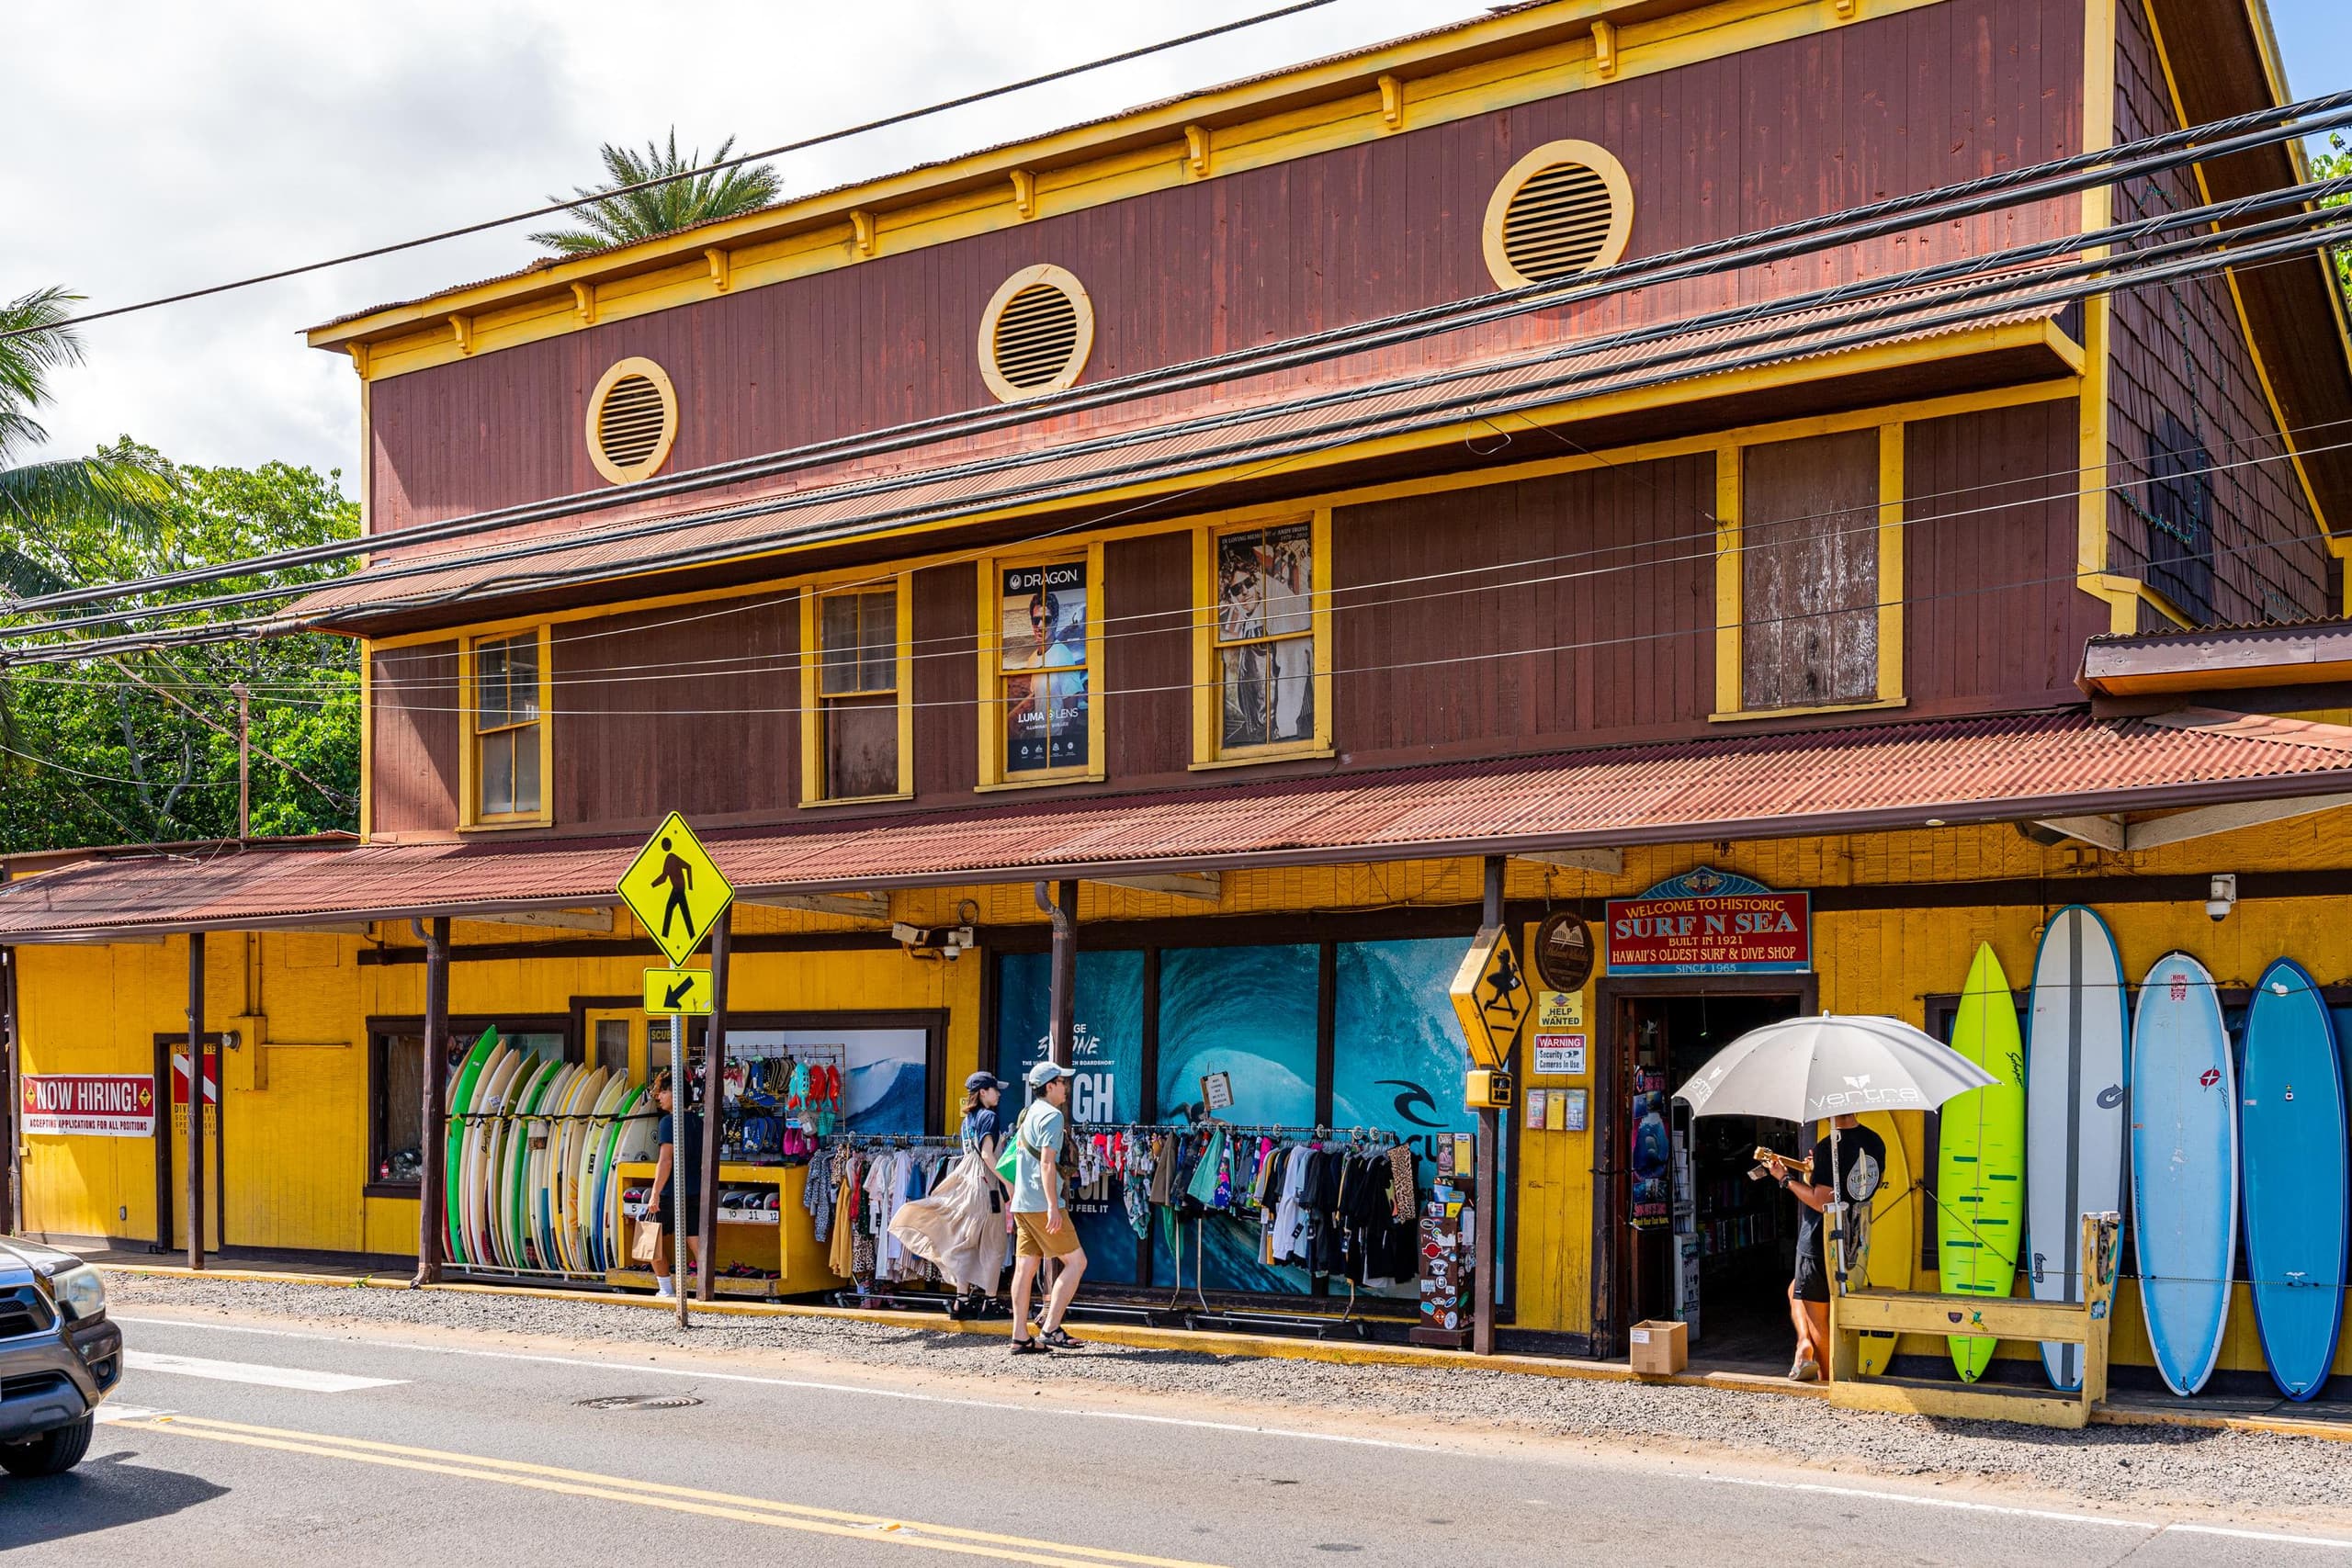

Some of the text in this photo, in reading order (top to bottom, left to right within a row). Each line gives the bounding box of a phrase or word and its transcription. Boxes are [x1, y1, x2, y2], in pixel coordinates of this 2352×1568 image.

[1023, 569, 1078, 587] DRAGON
[1018, 707, 1079, 723] LUMA LENS
[1625, 899, 1785, 919] WELCOME TO HISTORIC
[1615, 911, 1798, 940] SURF N SEA
[1669, 935, 1743, 946] BUILT IN 1921
[1612, 946, 1796, 963] HAWAII'S OLDEST SURF & DIVE SHOP
[1676, 963, 1736, 973] SINCE 1965
[1542, 1017, 1579, 1025] WANTED
[650, 1030, 672, 1040] SCUB
[1539, 1038, 1581, 1047] WARNING
[1539, 1050, 1563, 1059] Security
[1540, 1060, 1562, 1068] Cameras
[1570, 1060, 1579, 1068] Use
[37, 1082, 138, 1111] NOW HIRING!
[1808, 1088, 1919, 1108] vertra
[29, 1119, 147, 1132] ACCEPTING APPLICATIONS FOR ALL POSITIONS
[631, 1204, 637, 1213] 5
[1076, 1204, 1097, 1213] FEEL
[1100, 1204, 1109, 1213] IT
[729, 1210, 778, 1221] 10 11 12
